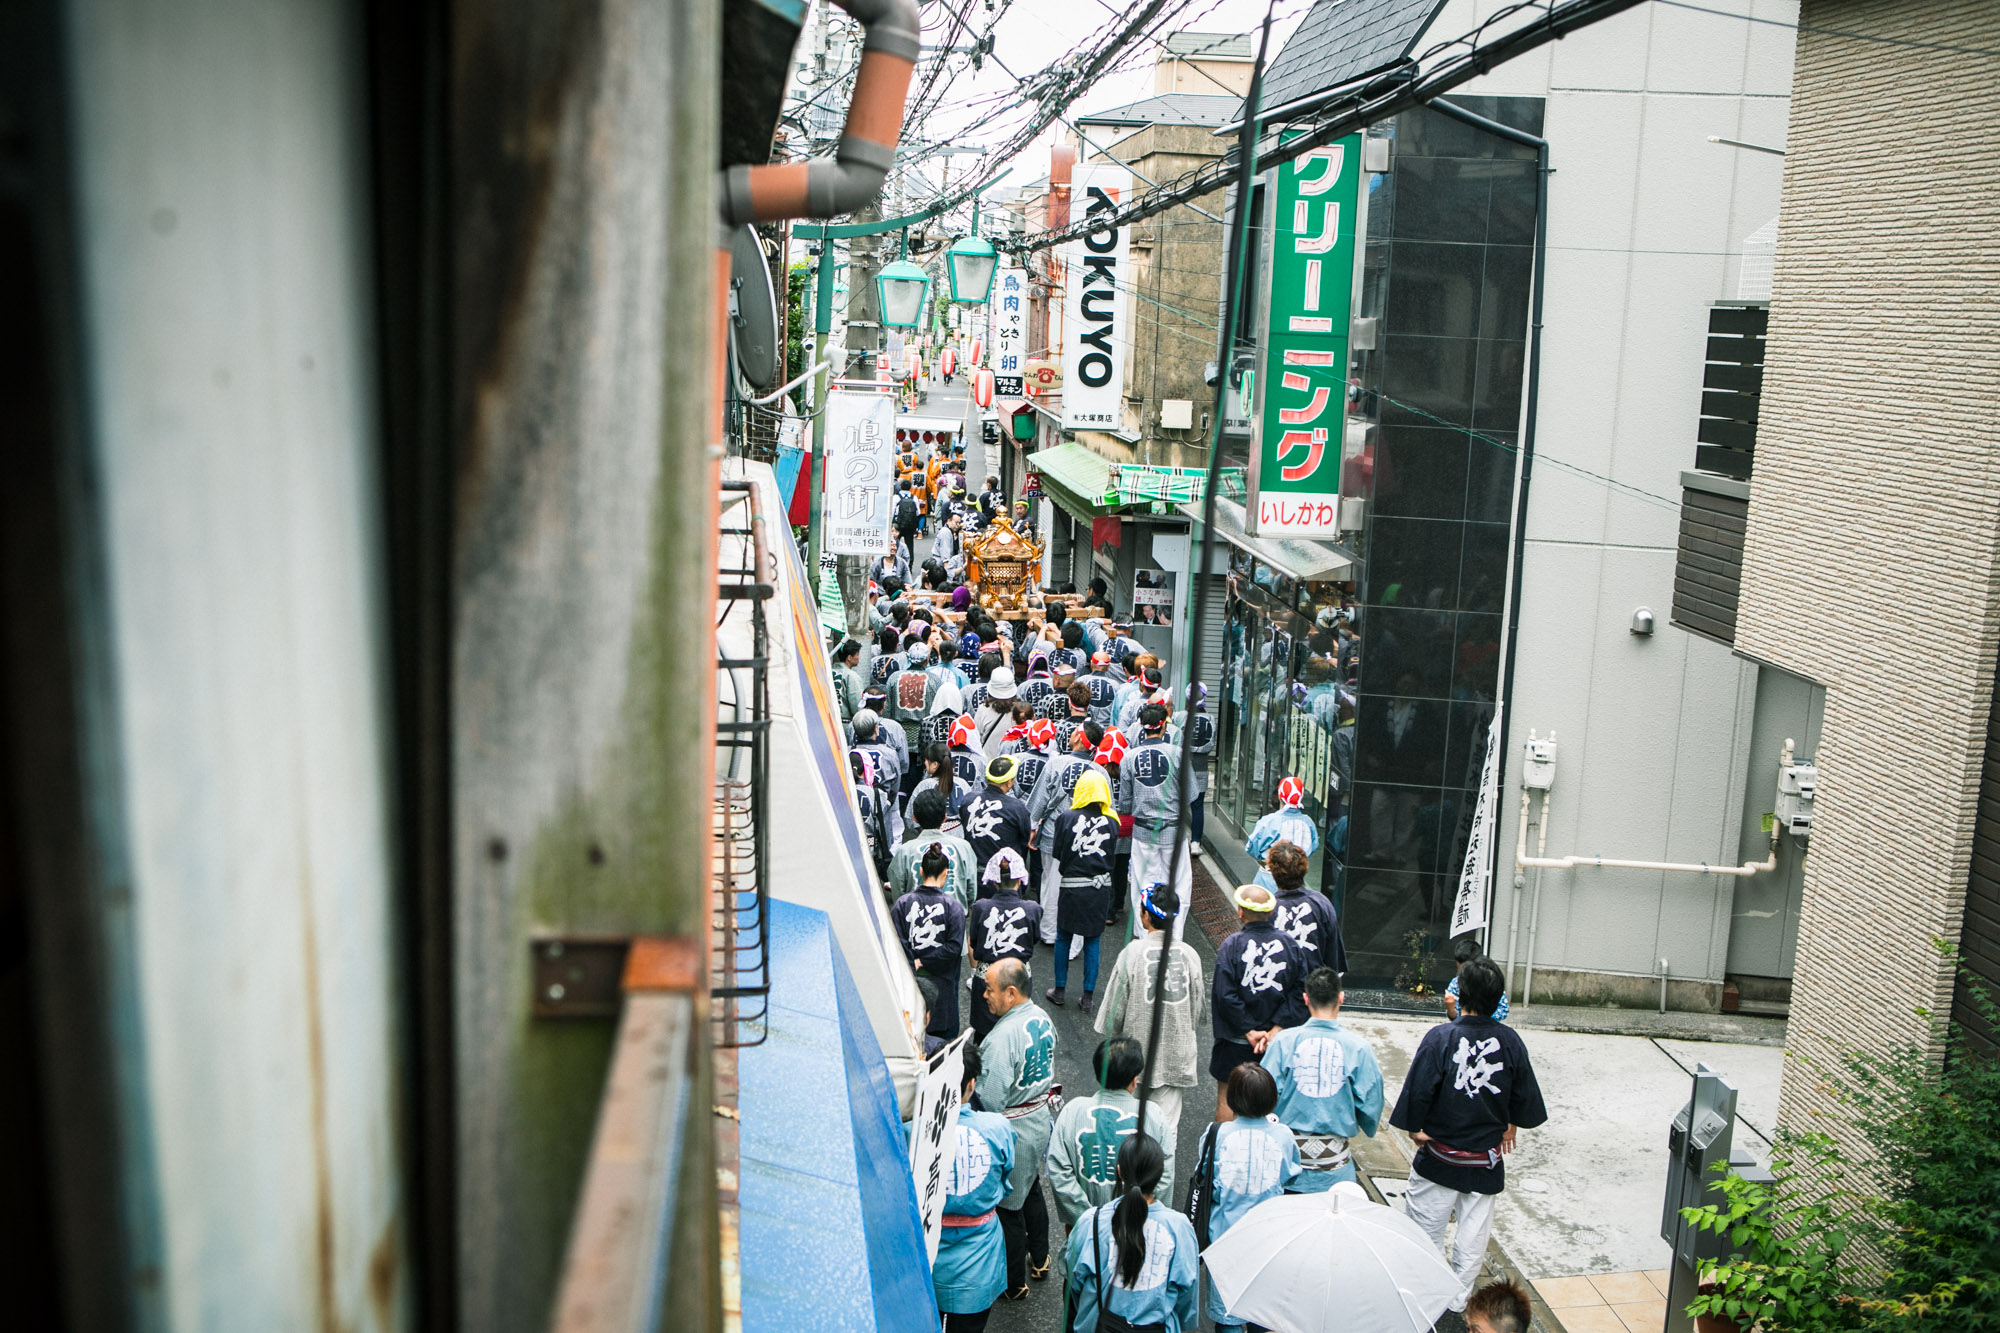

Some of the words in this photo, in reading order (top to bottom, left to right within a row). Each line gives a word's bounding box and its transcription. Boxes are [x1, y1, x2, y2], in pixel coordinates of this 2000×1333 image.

[1078, 186, 1119, 388] KOKUYO
[1277, 144, 1344, 481] クリーニング
[996, 378, 1017, 386] マルミ
[1001, 354, 1017, 371] 卵
[1000, 386, 1022, 394] チキン
[839, 419, 883, 522] 鳩の街
[1261, 501, 1333, 527] いしかわ
[966, 796, 1003, 841] 桜
[1071, 815, 1110, 858] 桜
[906, 901, 945, 950] 桜
[984, 907, 1028, 956] 桜
[1241, 939, 1287, 994] 桜
[1453, 1037, 1504, 1099] 桜
[1191, 1189, 1200, 1213] DEAN
